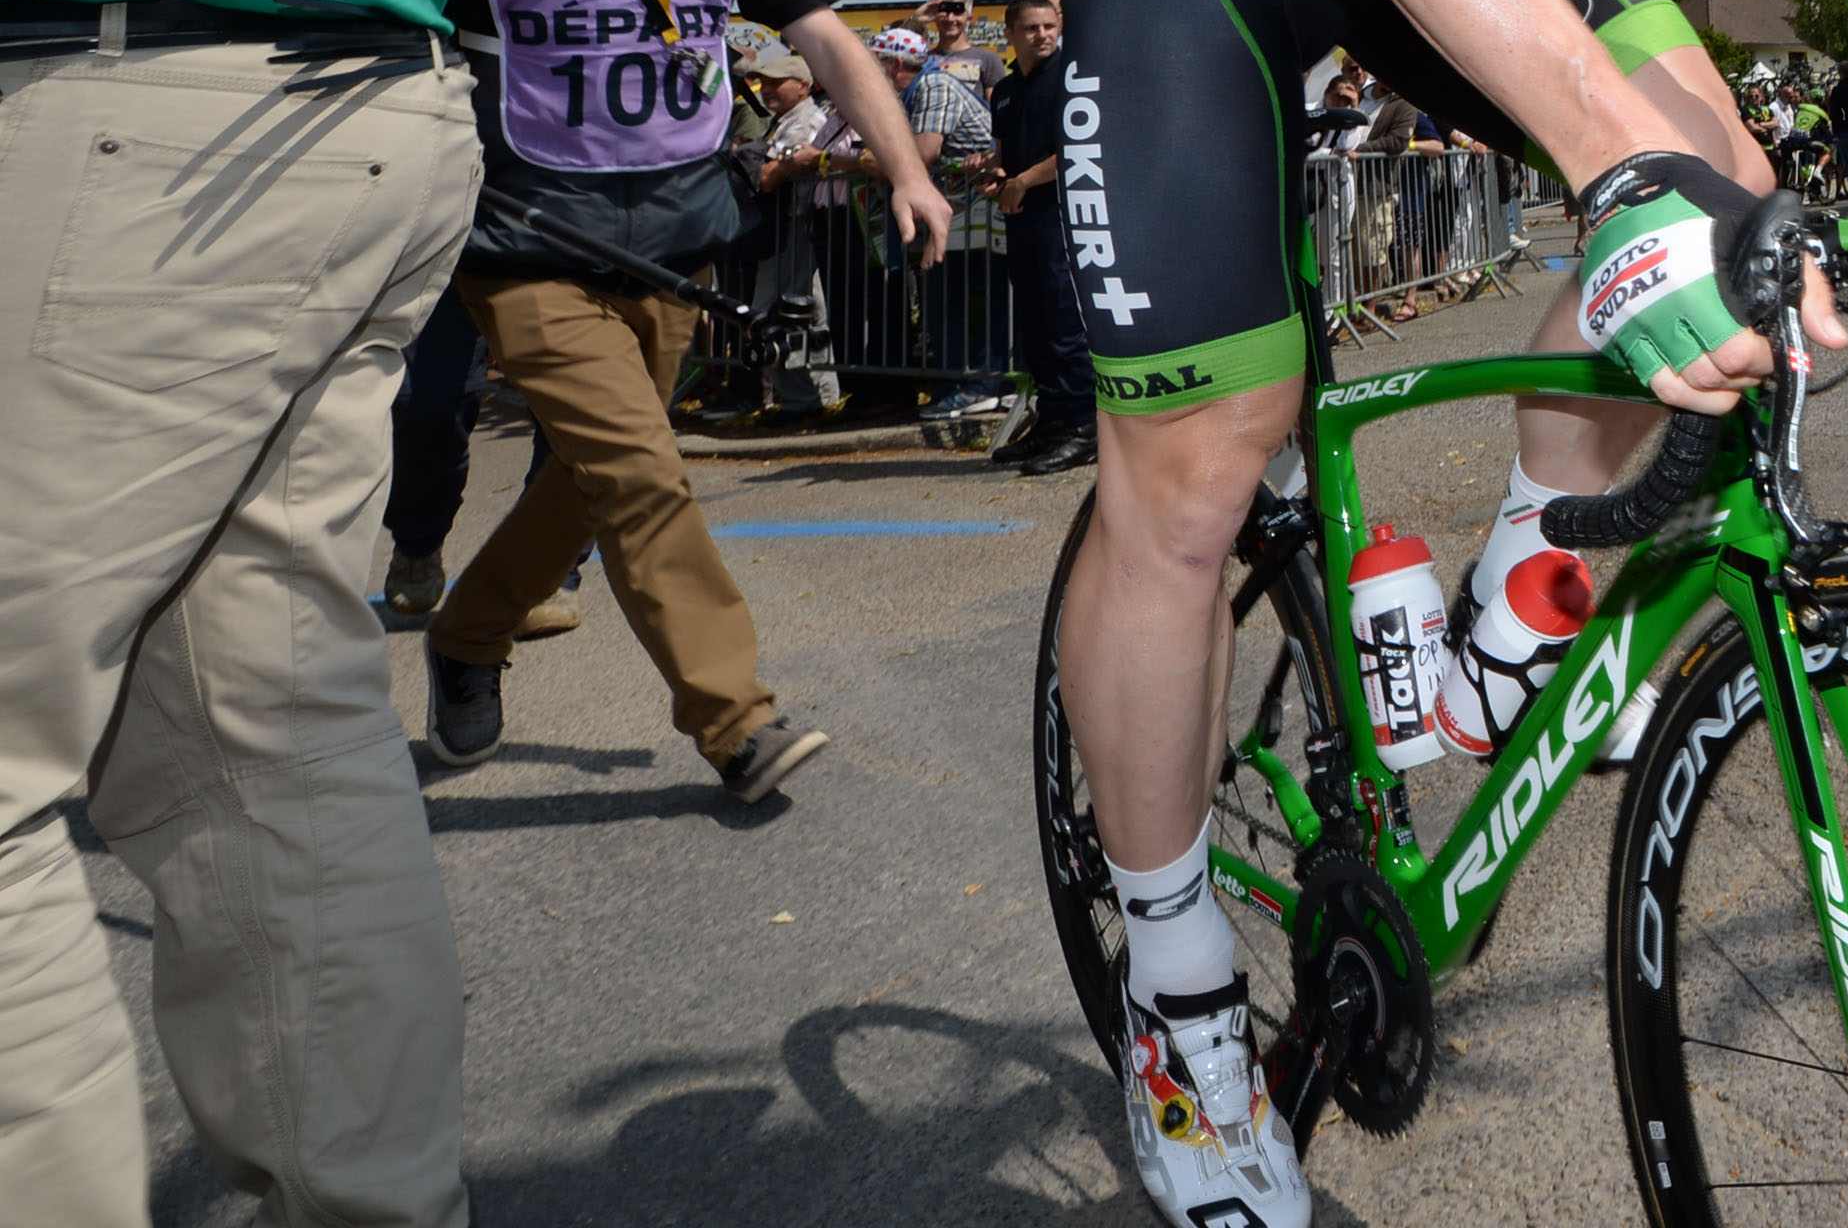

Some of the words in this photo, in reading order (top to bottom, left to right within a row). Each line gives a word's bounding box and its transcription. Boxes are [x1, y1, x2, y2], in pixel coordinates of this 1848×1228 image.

[550, 52, 702, 128] 100
[1591, 237, 1660, 297] LOTTO
[1589, 267, 1668, 336] SOUDAL
[1096, 364, 1213, 400] UDAL
[1318, 370, 1429, 410] RIDLEY
[1422, 608, 1443, 621] LOTTO
[1380, 647, 1407, 658] Tacx
[1441, 599, 1637, 931] RIDLEY
[1249, 897, 1281, 924] SOUDAL
